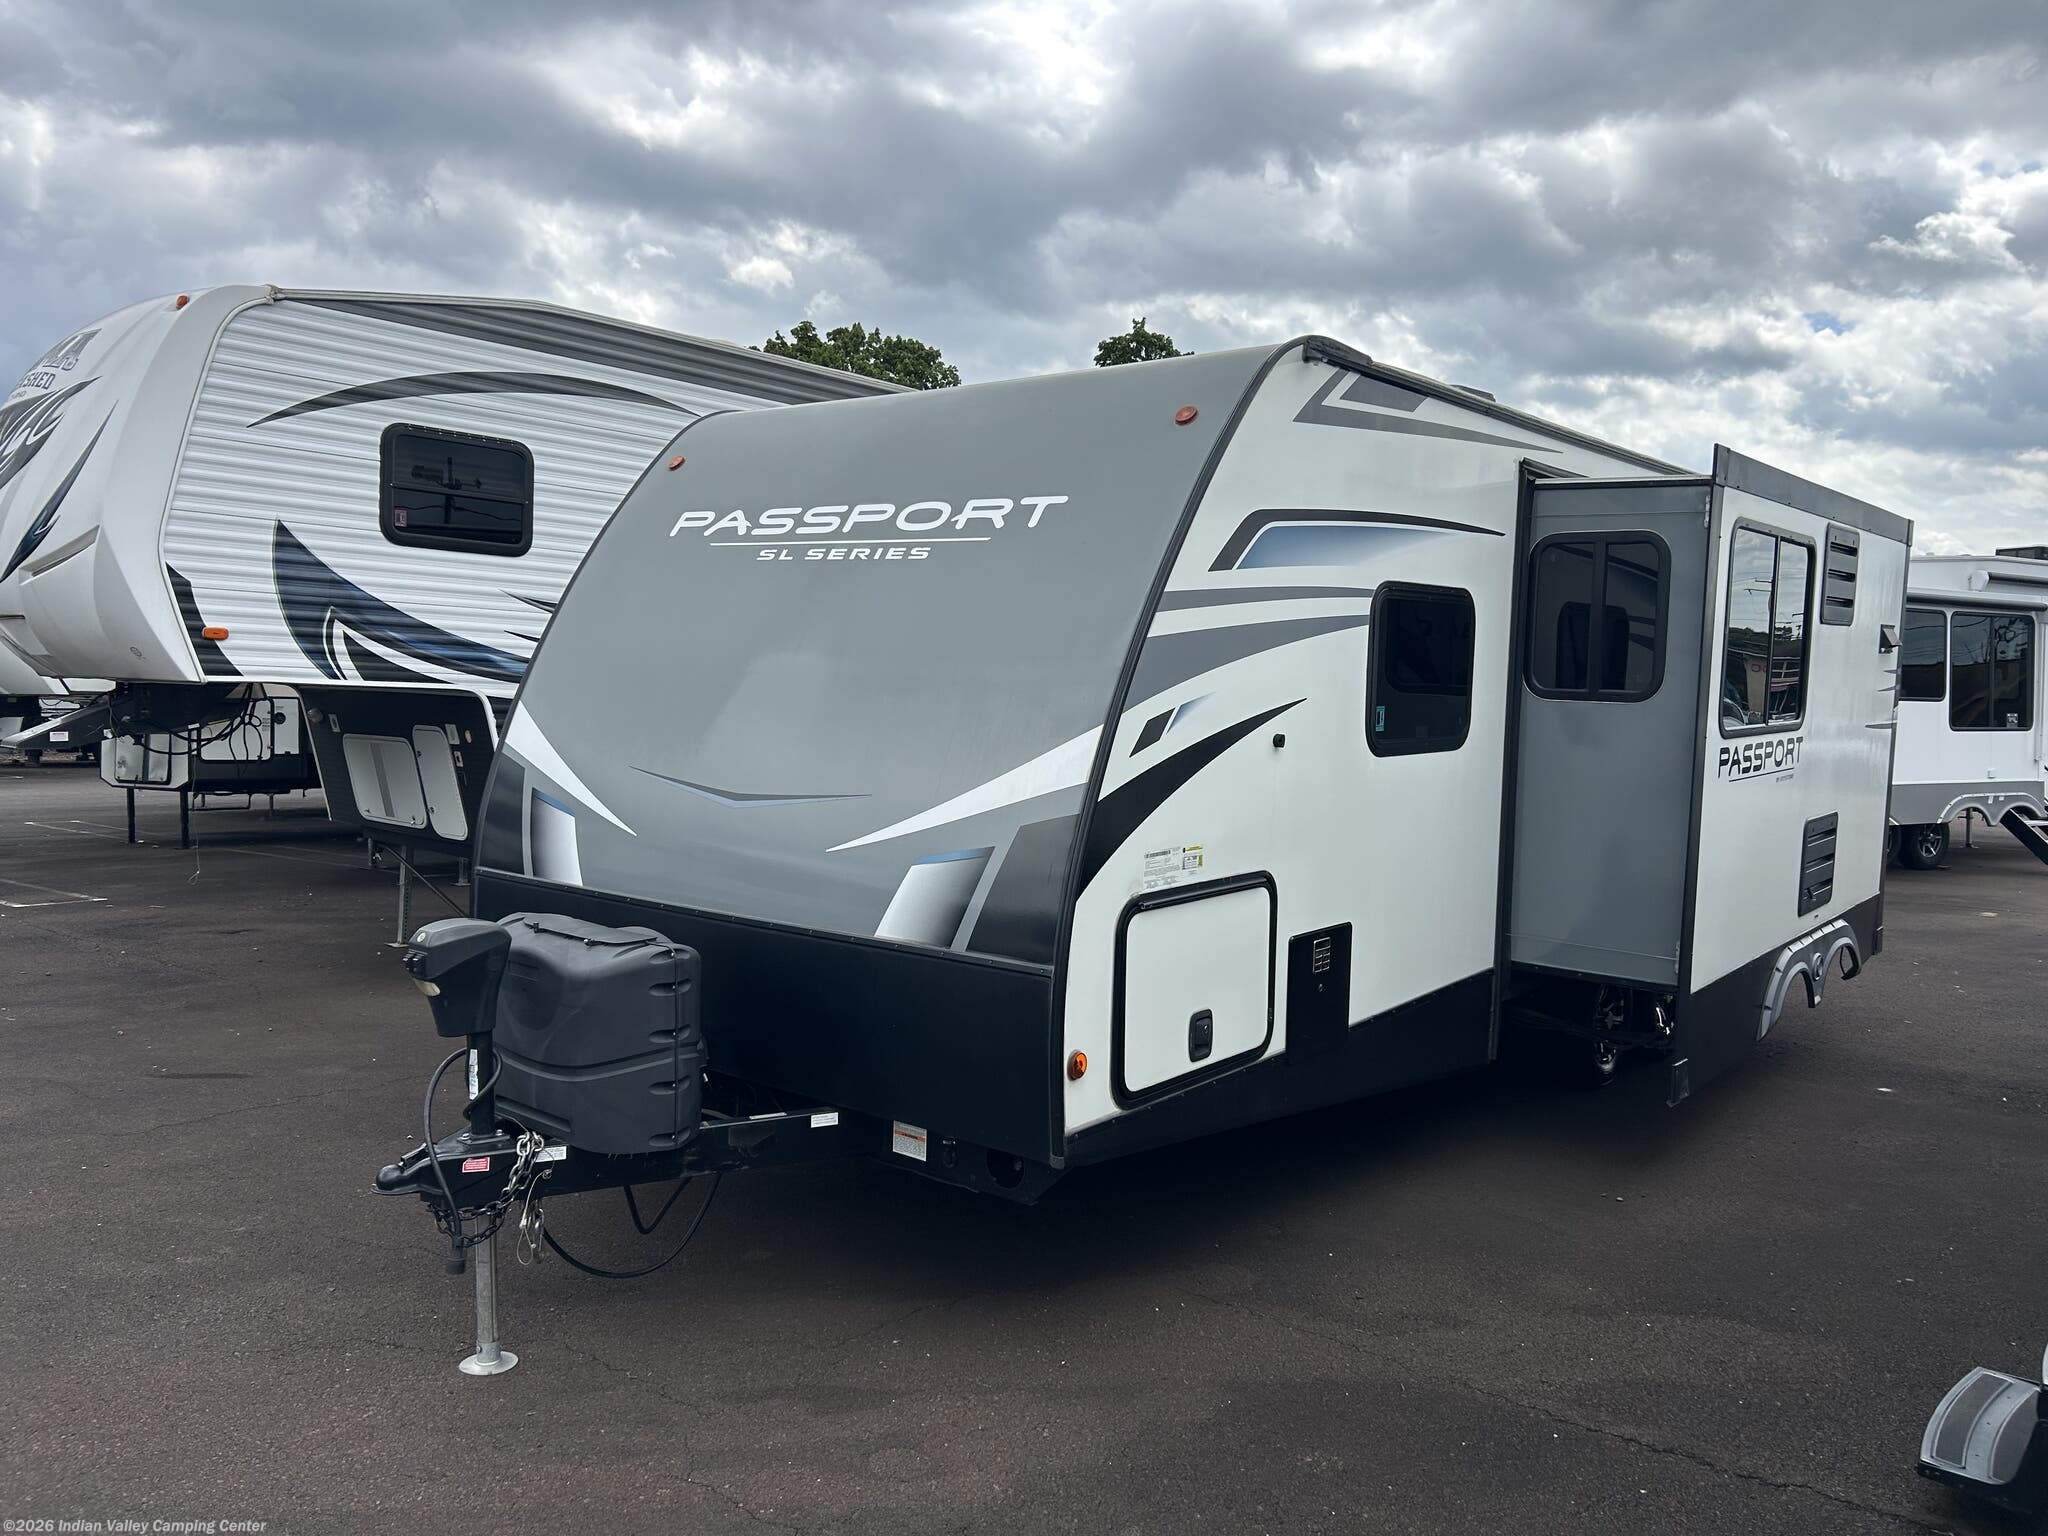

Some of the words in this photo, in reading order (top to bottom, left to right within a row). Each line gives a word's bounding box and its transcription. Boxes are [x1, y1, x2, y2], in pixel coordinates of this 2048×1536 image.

[669, 495, 1069, 537] PASSPORT
[756, 548, 793, 561] SL
[804, 547, 931, 561] SERIES
[1717, 736, 1804, 779] PASSPORT
